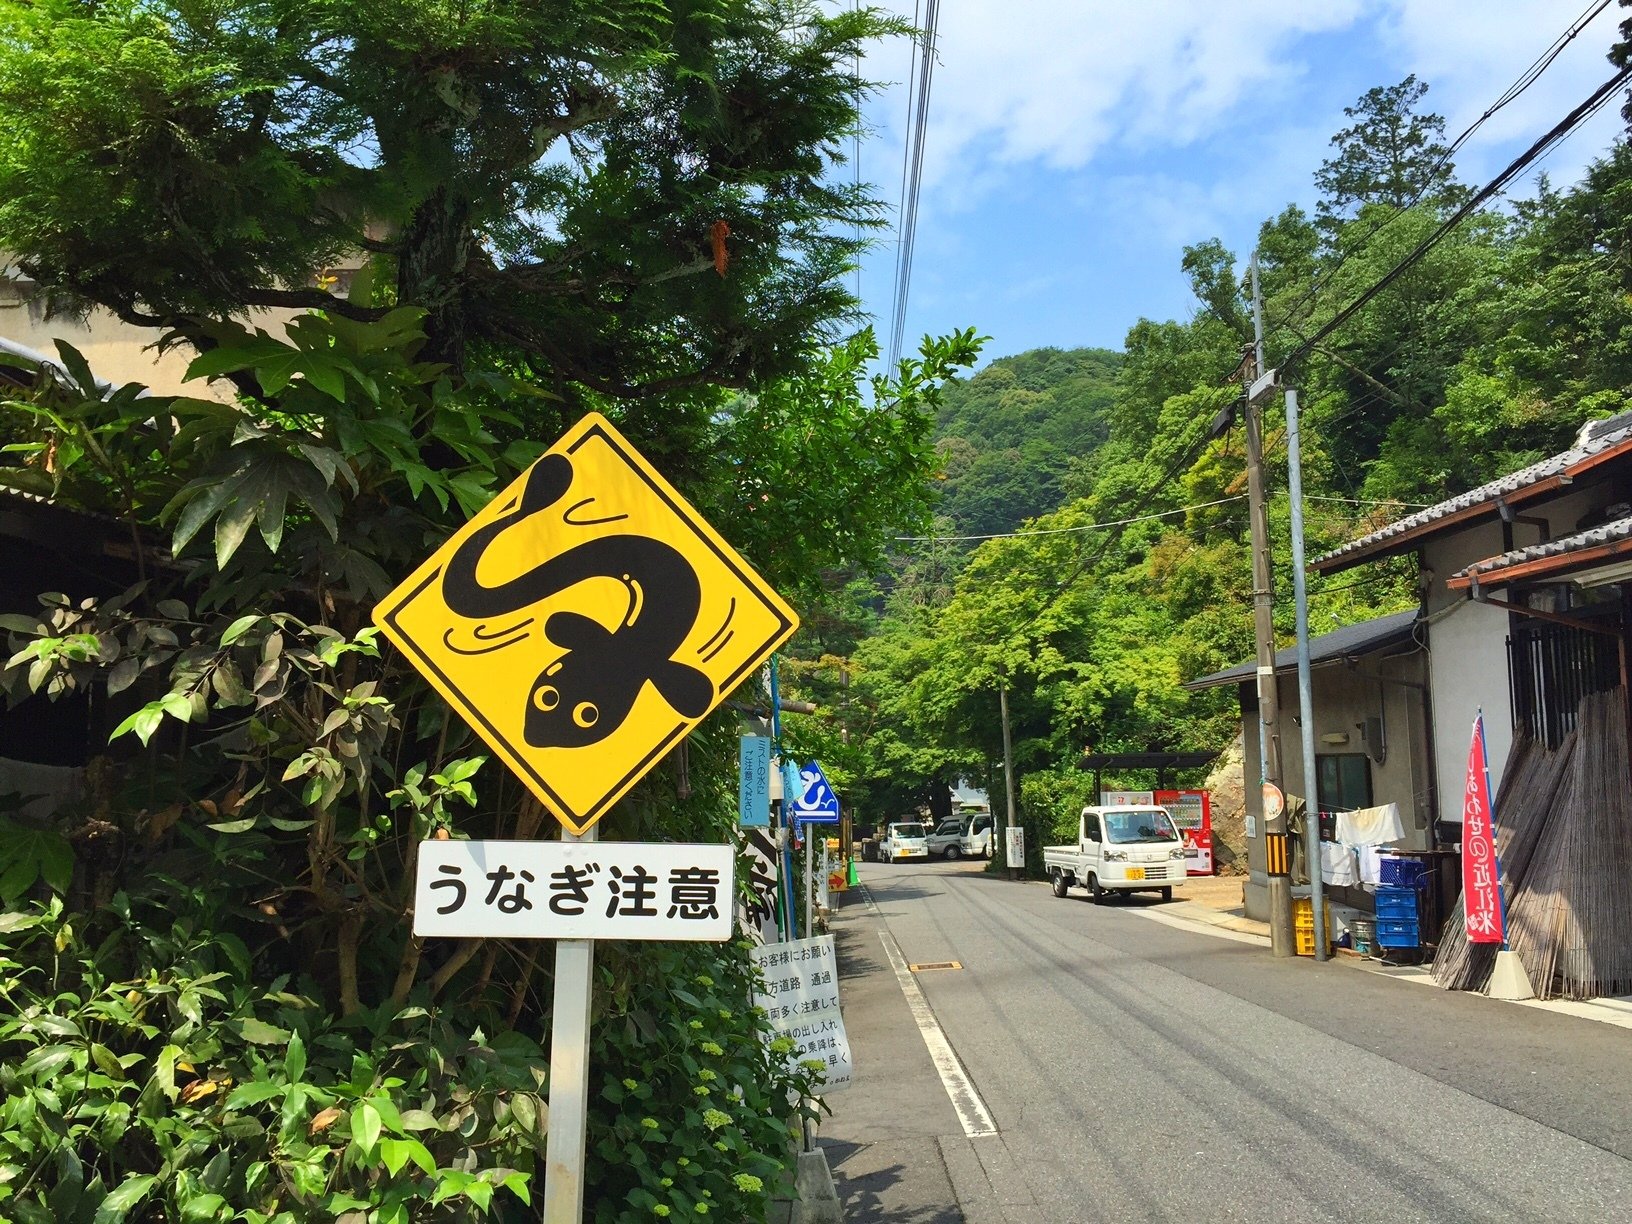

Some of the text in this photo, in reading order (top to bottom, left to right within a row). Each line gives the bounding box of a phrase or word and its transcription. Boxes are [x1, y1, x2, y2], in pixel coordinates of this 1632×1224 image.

[756, 740, 766, 795] ミストの水に
[430, 862, 720, 920] うなぎ注意
[758, 945, 831, 969] お客様にお願い
[759, 970, 831, 997] 方道路 通過
